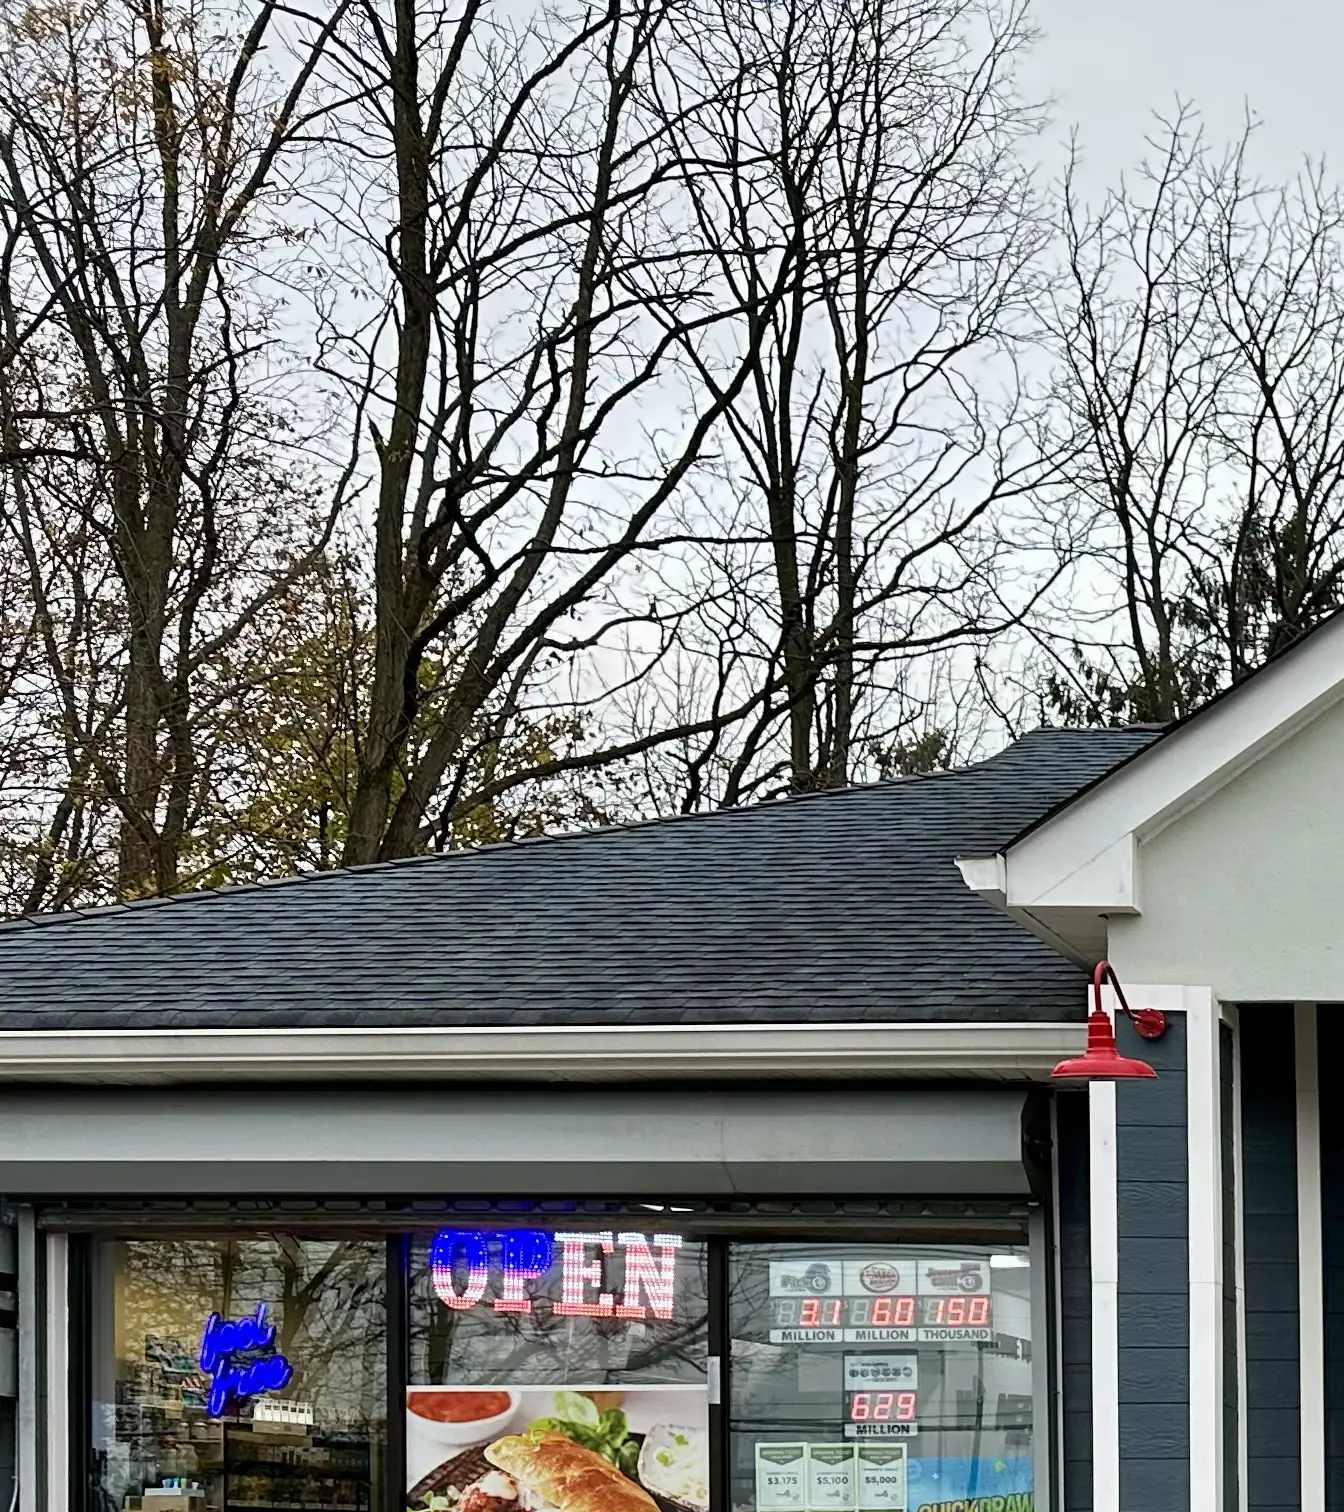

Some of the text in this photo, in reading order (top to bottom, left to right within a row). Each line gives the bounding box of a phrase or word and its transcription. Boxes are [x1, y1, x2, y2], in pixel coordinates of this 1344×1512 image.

[431, 1230, 683, 1319] OPEN
[872, 1298, 914, 1326] 60
[935, 1298, 988, 1325] 150
[781, 1330, 835, 1341] MILLION
[855, 1330, 909, 1340] MILLION
[923, 1329, 989, 1340] THOUSAND
[851, 1393, 915, 1420] 629
[856, 1425, 910, 1434] MILLION
